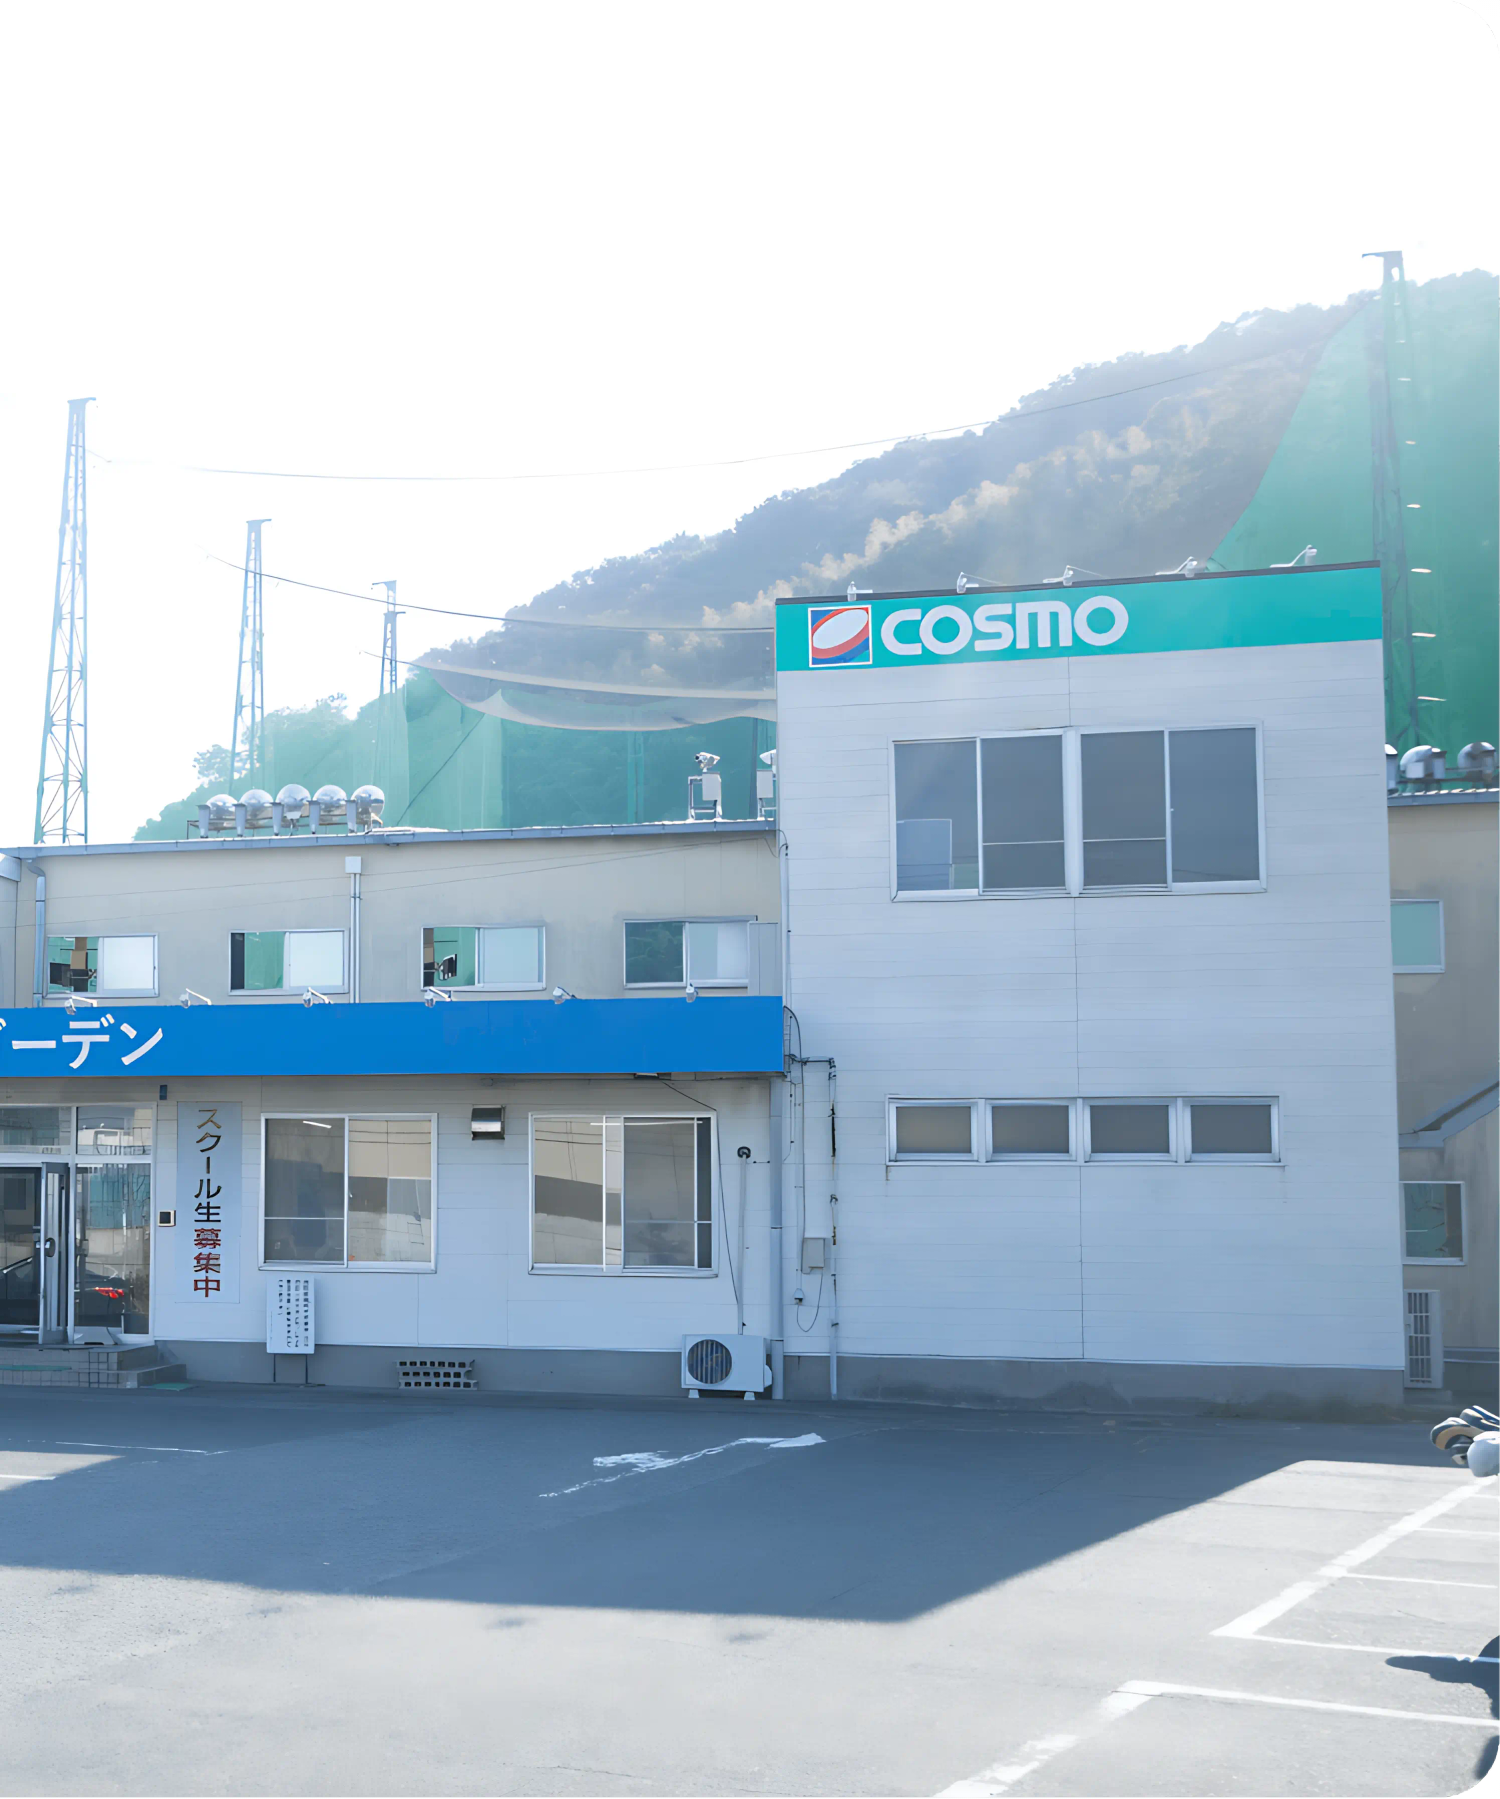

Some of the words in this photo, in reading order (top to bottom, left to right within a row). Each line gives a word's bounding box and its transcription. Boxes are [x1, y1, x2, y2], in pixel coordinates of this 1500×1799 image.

[880, 595, 1129, 656] COSMO
[194, 1107, 222, 1298] スクール生募集中
